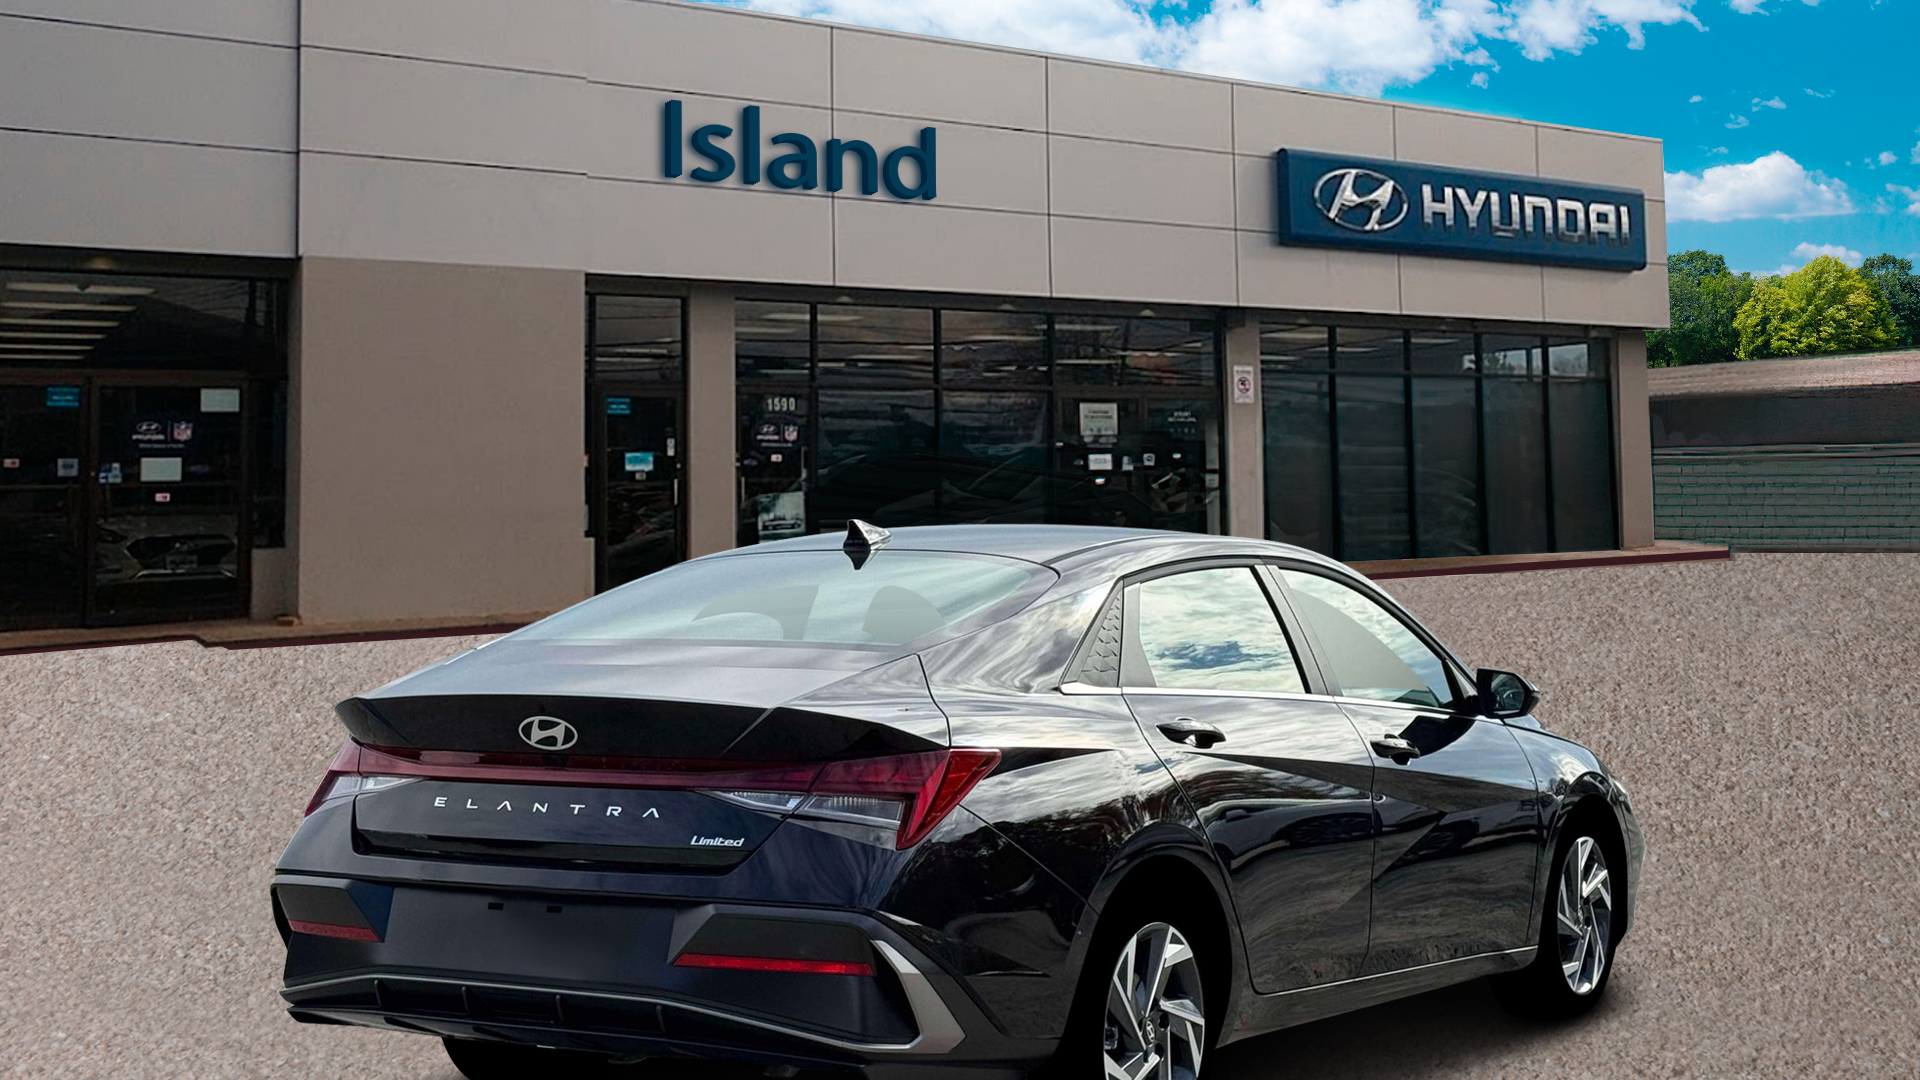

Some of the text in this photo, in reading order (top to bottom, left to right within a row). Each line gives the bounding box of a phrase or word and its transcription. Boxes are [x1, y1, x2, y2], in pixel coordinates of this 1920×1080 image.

[664, 99, 937, 200] Island
[1422, 183, 1630, 245] HYUNDAI
[767, 397, 796, 411] 1590
[433, 796, 660, 819] ELANTRA
[690, 835, 745, 848] Limited
